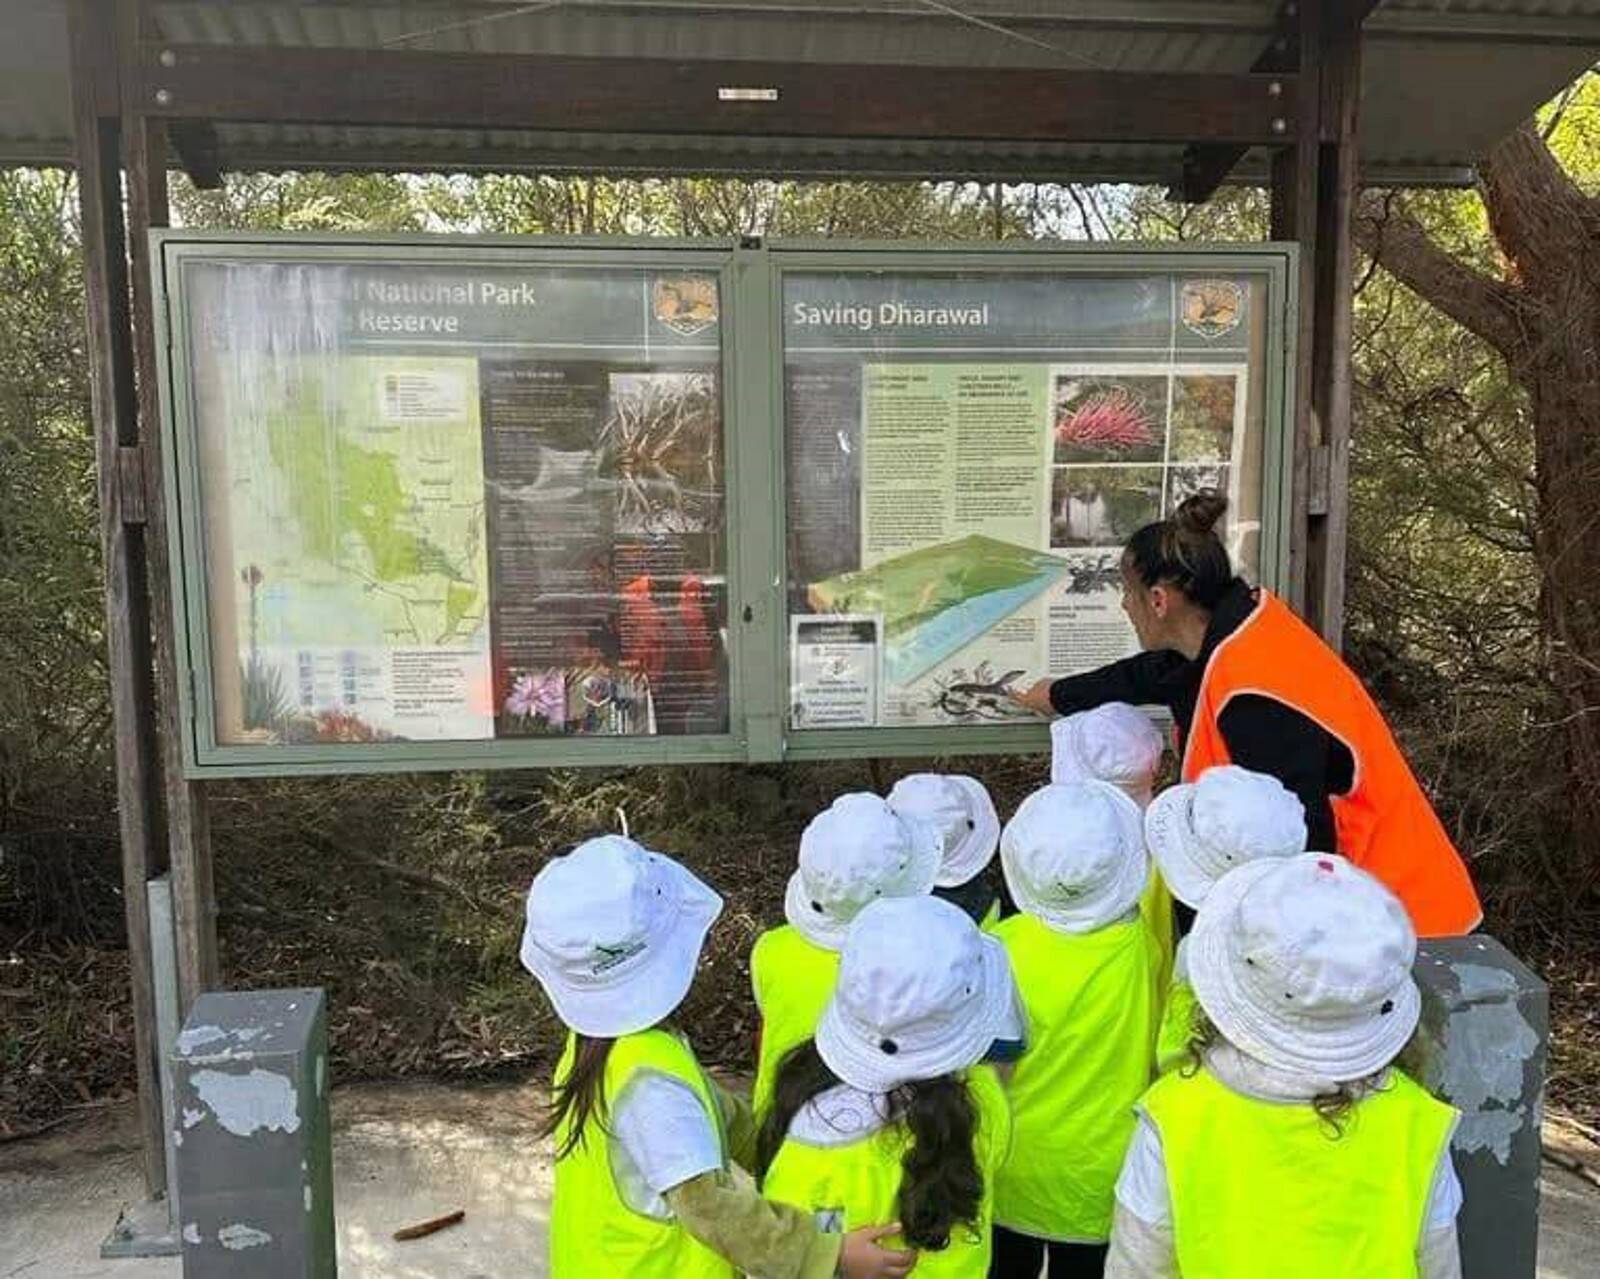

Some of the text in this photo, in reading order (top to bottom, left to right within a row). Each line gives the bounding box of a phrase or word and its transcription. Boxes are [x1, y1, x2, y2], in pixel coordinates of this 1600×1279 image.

[367, 282, 473, 304] National
[481, 282, 535, 305] Park
[359, 308, 459, 333] Reserve
[793, 302, 989, 331] Saving Dharawal
